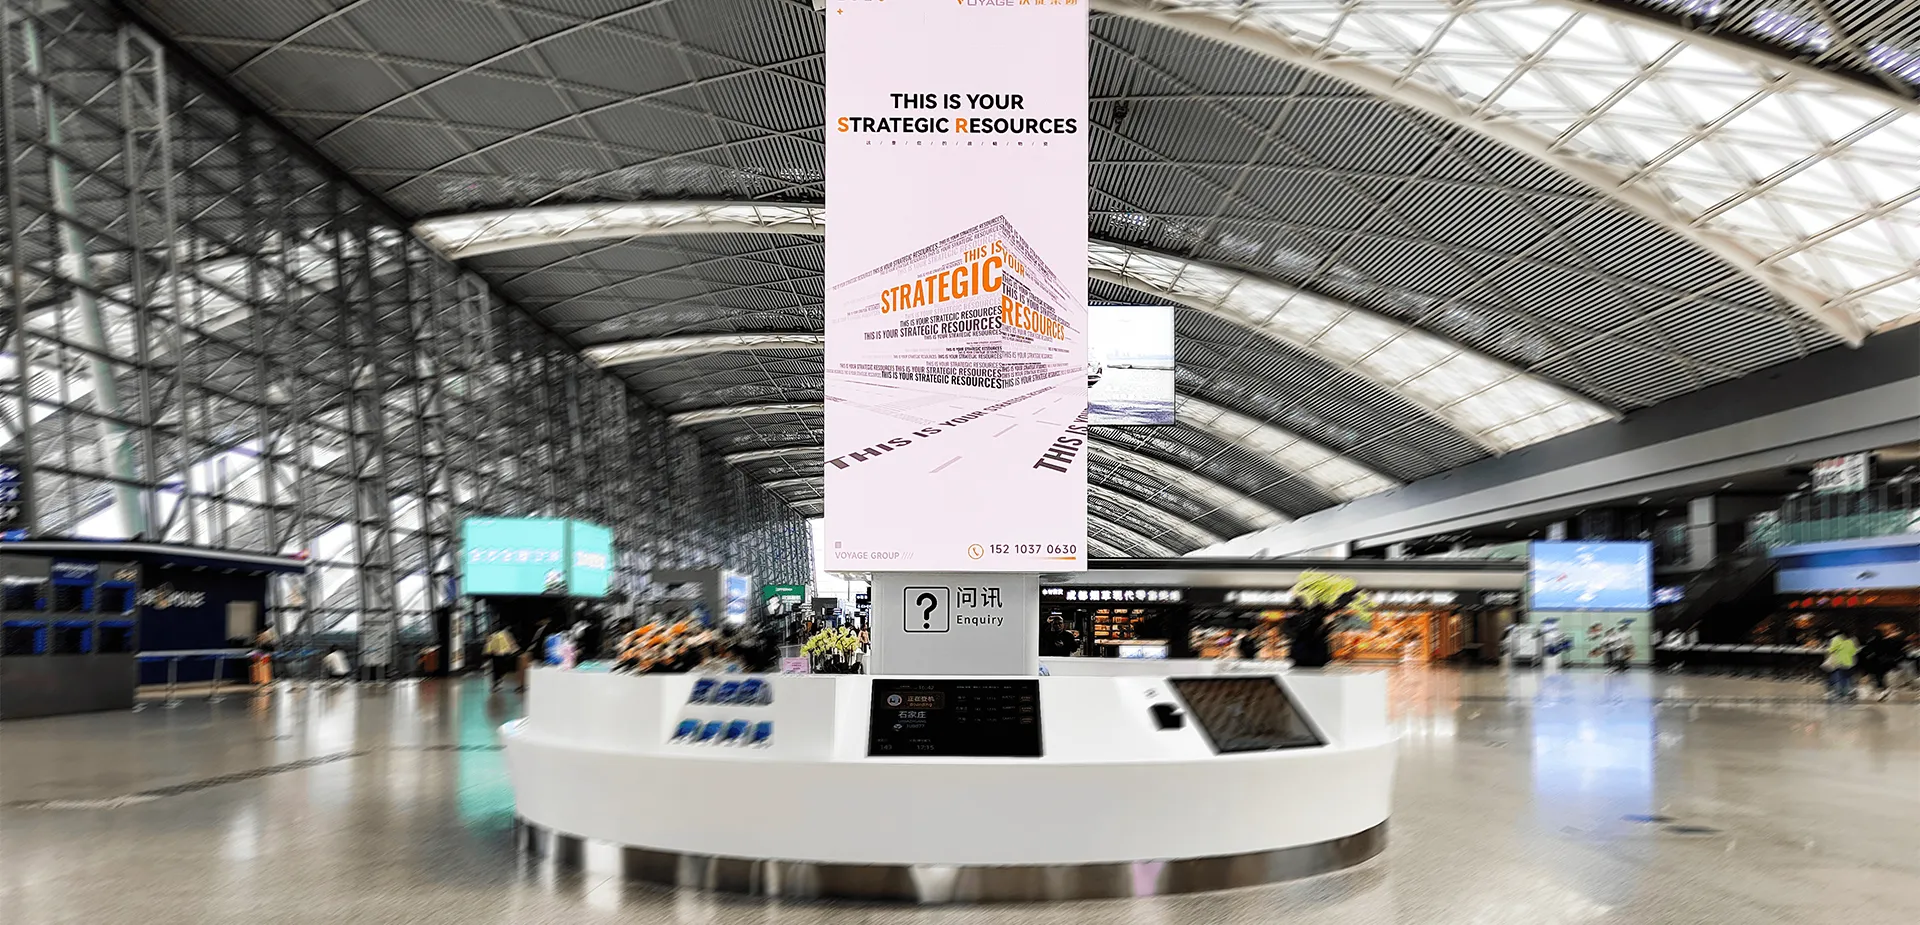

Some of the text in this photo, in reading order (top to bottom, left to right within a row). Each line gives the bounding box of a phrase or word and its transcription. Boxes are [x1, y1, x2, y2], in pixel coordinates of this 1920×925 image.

[890, 93, 1024, 110] THIS IS YOUR
[837, 117, 1078, 134] STRATEGIC RESOURCES
[964, 240, 1003, 263] THIS IS
[1003, 247, 1024, 277] YOUR
[881, 256, 1003, 314] STRATEGIC
[916, 317, 929, 326] YOUR
[930, 312, 960, 324] STRATEGIC
[961, 305, 1003, 319] RESOURCES
[1002, 294, 1065, 341] RESOURCES
[864, 316, 1003, 340] THIS IS YOUR STRATEGIC RESOURCES
[881, 371, 892, 379] THIS
[899, 372, 914, 381] YOUR
[914, 373, 949, 384] STRATEGIC
[951, 375, 1003, 389] RESOURCES
[824, 437, 912, 470] THIS
[912, 426, 942, 438] IS
[939, 410, 988, 427] YOUR
[1033, 436, 1083, 474] THIS
[1065, 424, 1088, 436] IS
[835, 552, 899, 560] VOYAGE GROUP
[990, 544, 1077, 554] 152 1037 0630
[956, 587, 1003, 609] 问讯
[957, 615, 1004, 626] Enquiry
[898, 710, 927, 719] 石家庄
